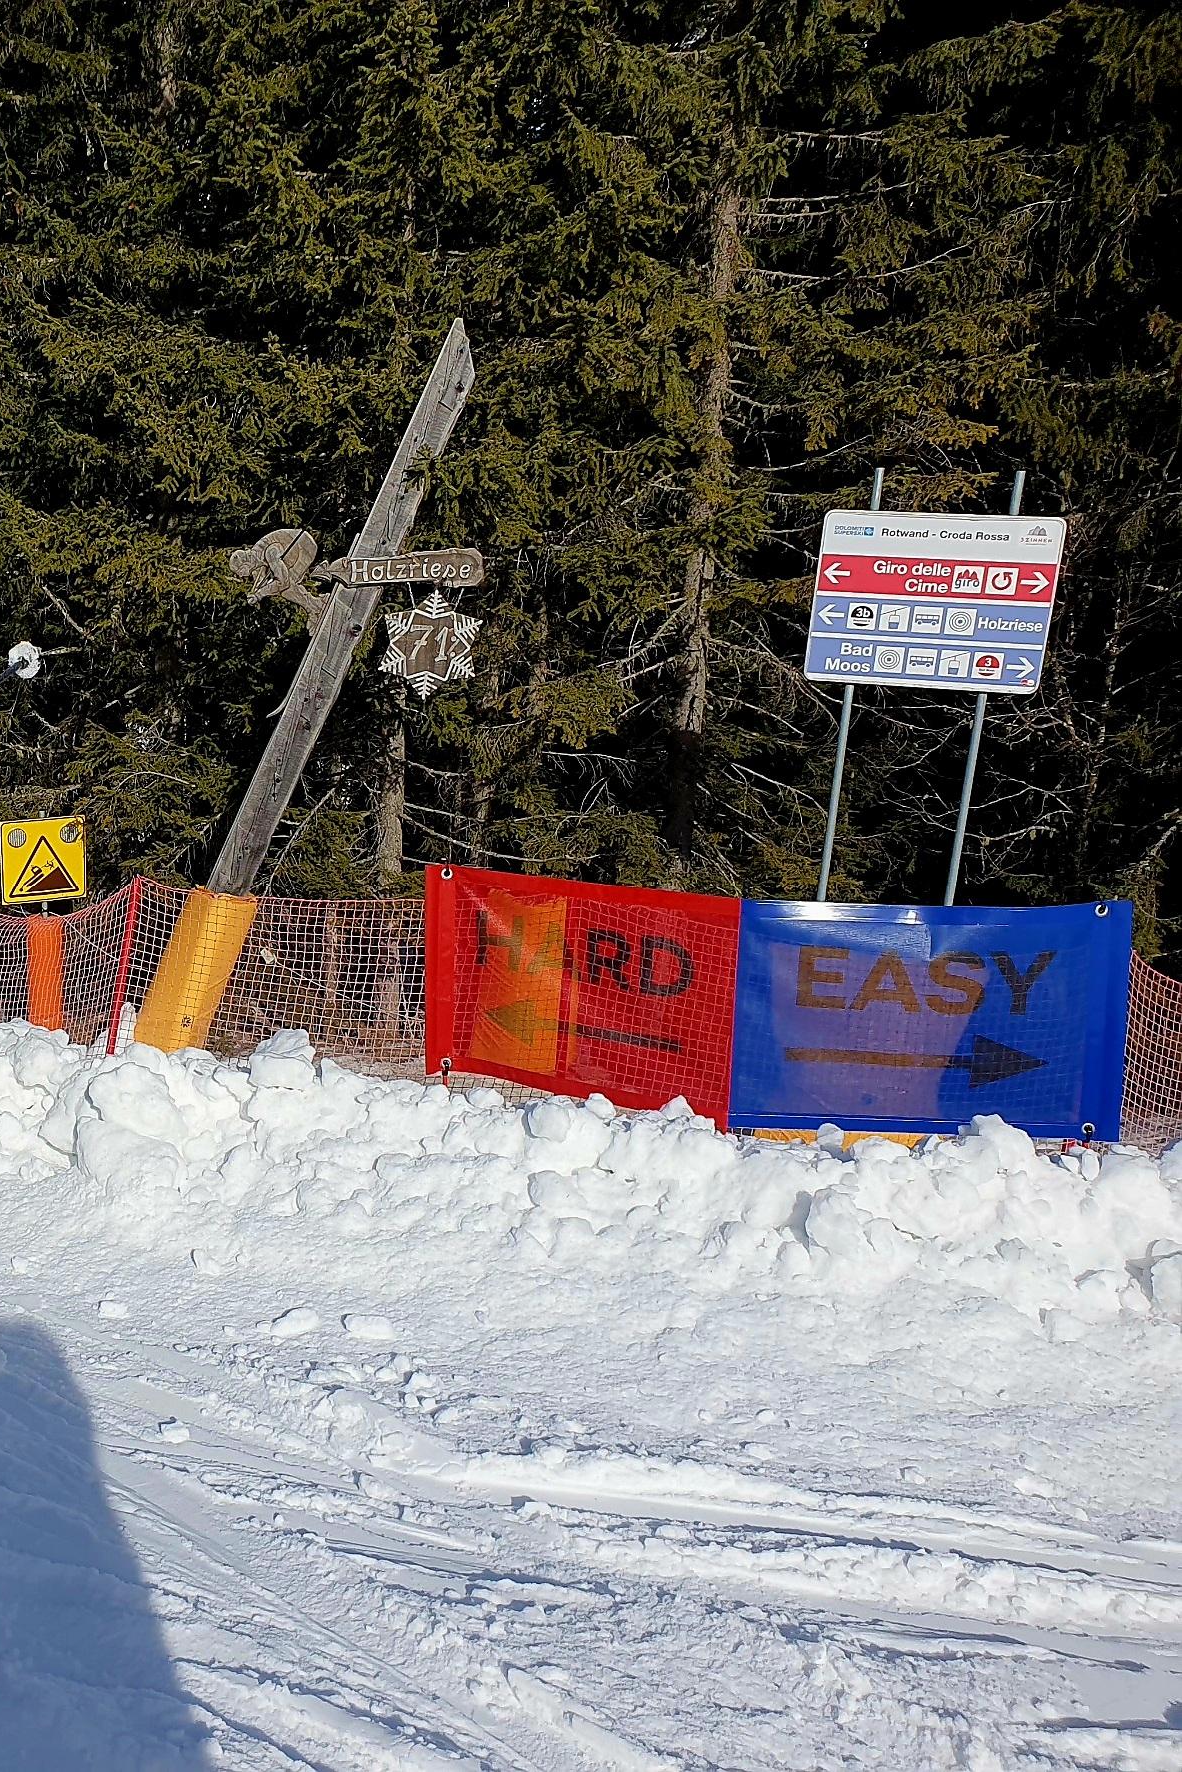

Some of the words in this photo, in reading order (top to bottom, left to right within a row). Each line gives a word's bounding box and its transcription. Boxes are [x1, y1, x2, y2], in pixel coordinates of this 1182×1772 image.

[881, 528, 929, 538] Rotwand
[939, 530, 972, 540] Croda
[975, 531, 1010, 541] Rossa
[350, 558, 472, 583] Holzriese
[873, 560, 908, 575] Giro
[911, 562, 952, 577] delle
[904, 578, 949, 593] Cime
[855, 607, 871, 618] 3b
[978, 616, 1043, 632] Holzriese
[840, 642, 874, 657] Bad
[824, 657, 871, 673] Moos
[984, 657, 992, 667] 3
[475, 909, 695, 997] HARD
[795, 944, 1057, 1016] EASY
